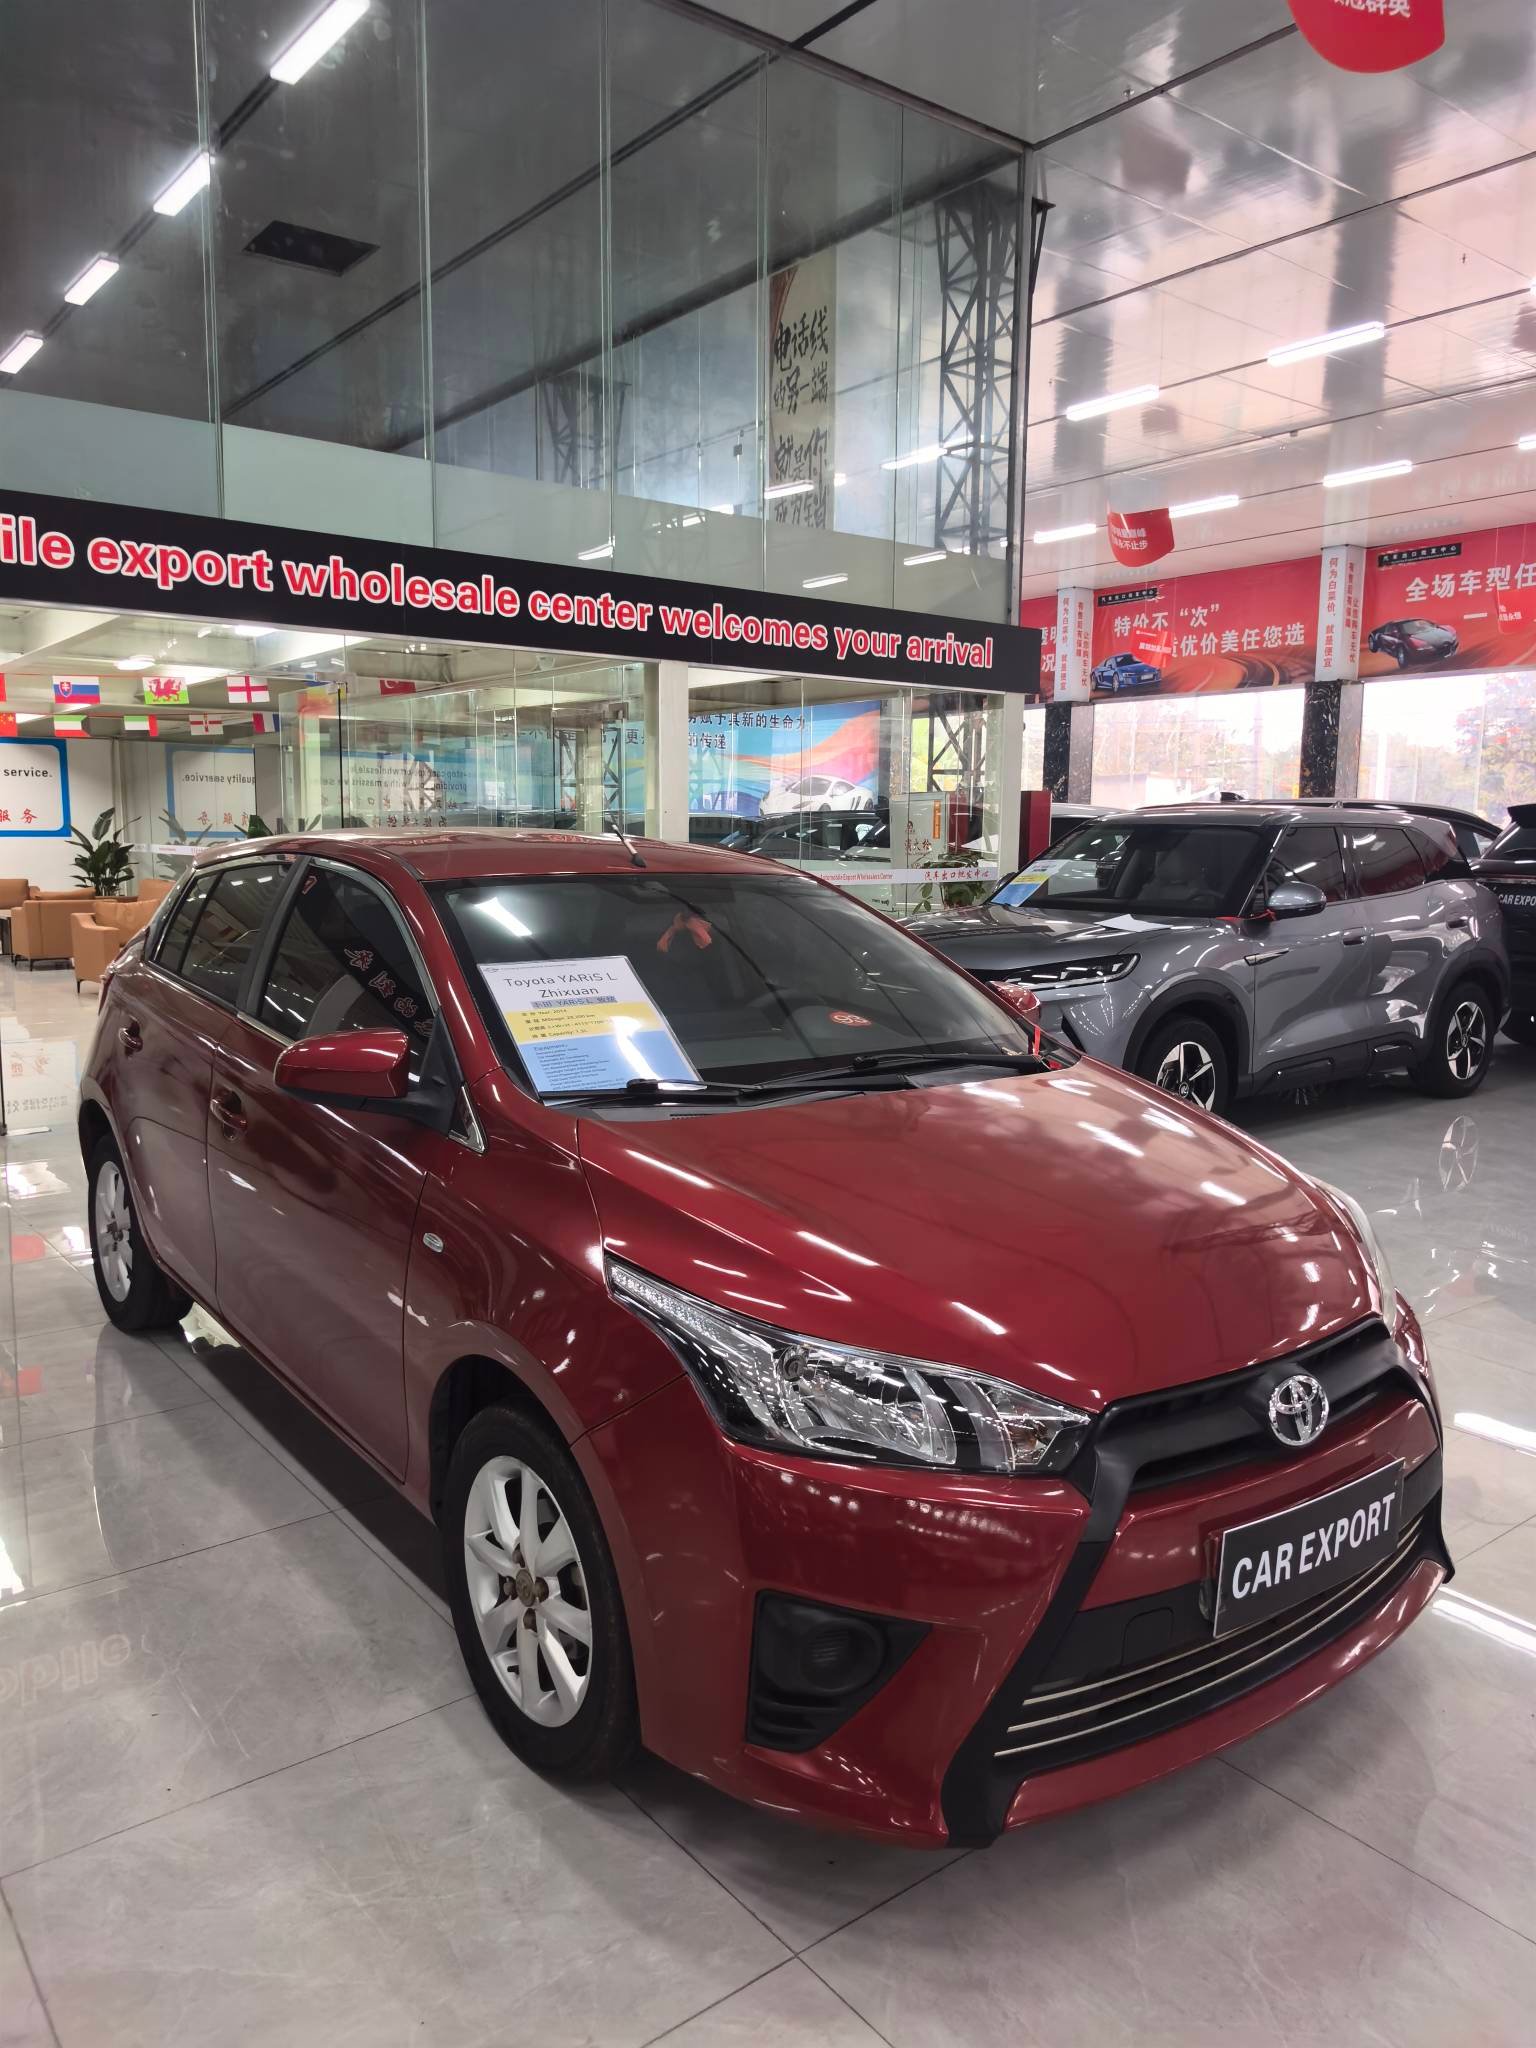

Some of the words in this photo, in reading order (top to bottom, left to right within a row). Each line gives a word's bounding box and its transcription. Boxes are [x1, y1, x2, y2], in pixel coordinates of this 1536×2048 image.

[0, 512, 76, 570] ile
[87, 536, 273, 592] export
[281, 555, 520, 618] wholesale
[528, 588, 653, 632] center
[660, 602, 828, 650] welcomes
[834, 624, 901, 661] your
[906, 632, 994, 669] arrival
[1405, 561, 1536, 603] 全场车型任
[1499, 894, 1514, 905] CAR
[504, 976, 556, 988] Toyota
[557, 972, 604, 983] YARiS
[606, 972, 618, 981] L
[539, 987, 599, 998] Zhixuan
[1232, 1542, 1293, 1600] CAR
[1299, 1491, 1396, 1575] EXPORT
